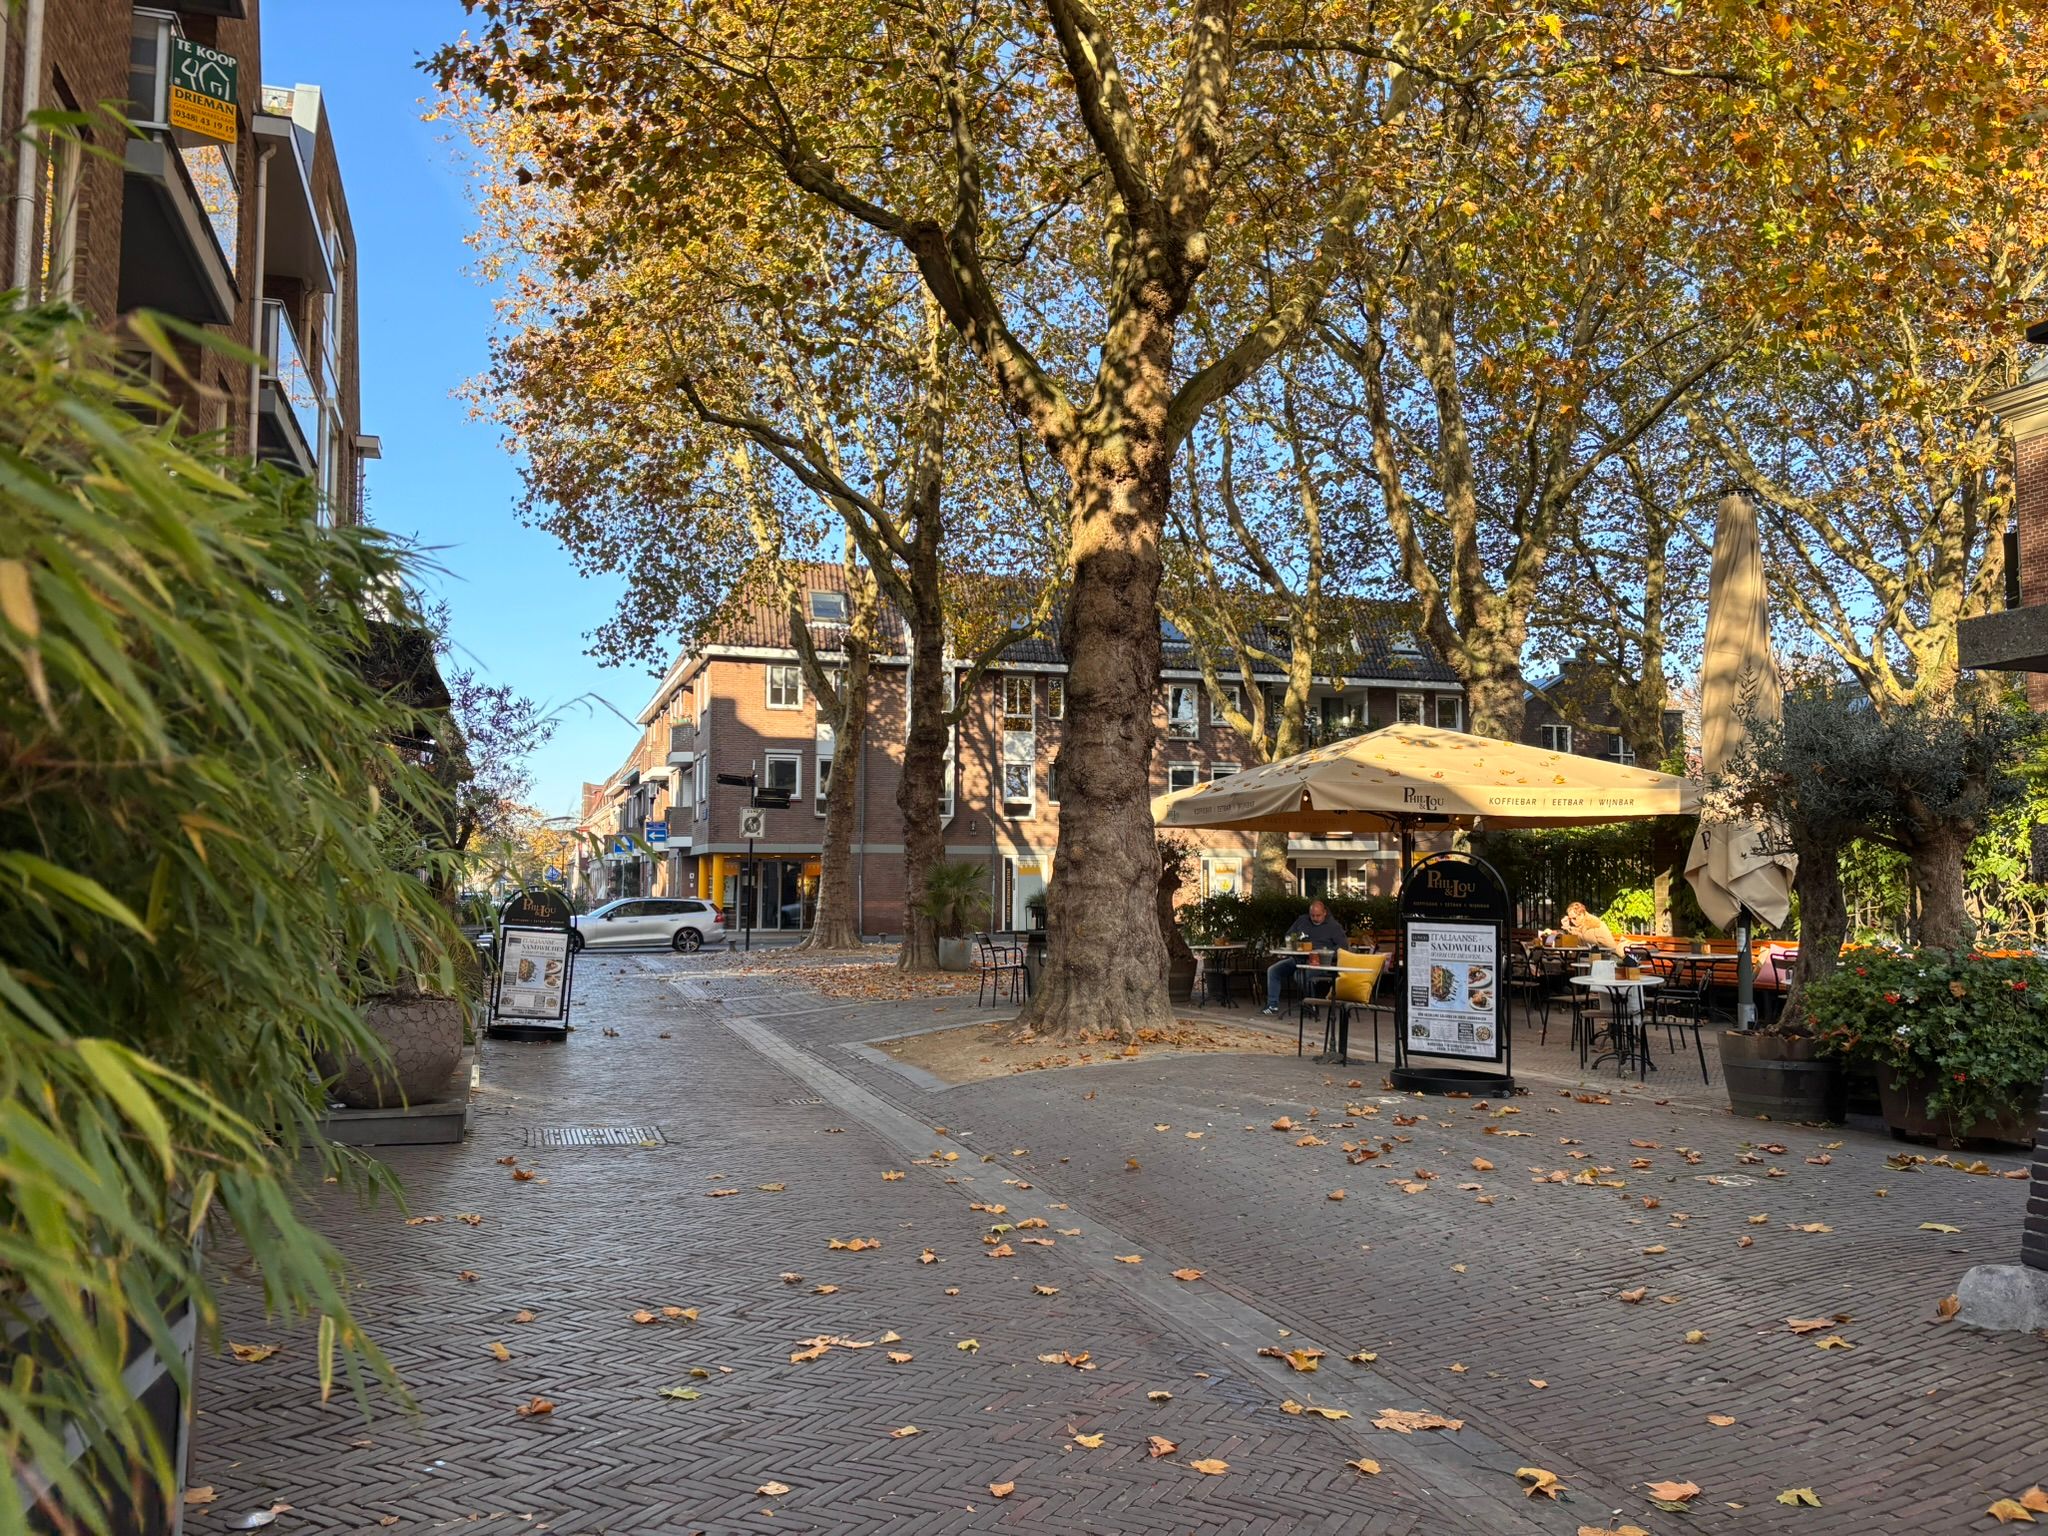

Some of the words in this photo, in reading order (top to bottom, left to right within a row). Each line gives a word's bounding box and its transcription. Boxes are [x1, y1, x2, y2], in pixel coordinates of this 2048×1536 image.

[176, 38, 192, 53] TE
[196, 45, 237, 68] KOOP
[175, 89, 235, 116] DRIEMAN
[173, 109, 198, 123] (0348)
[200, 117, 210, 126] 43
[213, 121, 223, 129] 19
[225, 125, 235, 134] 19
[1404, 787, 1426, 803] PHIL
[1426, 795, 1444, 811] LOU
[1489, 797, 1537, 806] KOFFIEBAR
[1552, 798, 1584, 806] EETBAR
[1598, 799, 1635, 808] WIJNBAR
[1427, 870, 1453, 888] PHIL
[1444, 888, 1453, 897] &
[1453, 880, 1476, 898] LOU
[1430, 943, 1493, 953] SANDWICHES
[1431, 933, 1478, 942] ITALIAANSE
